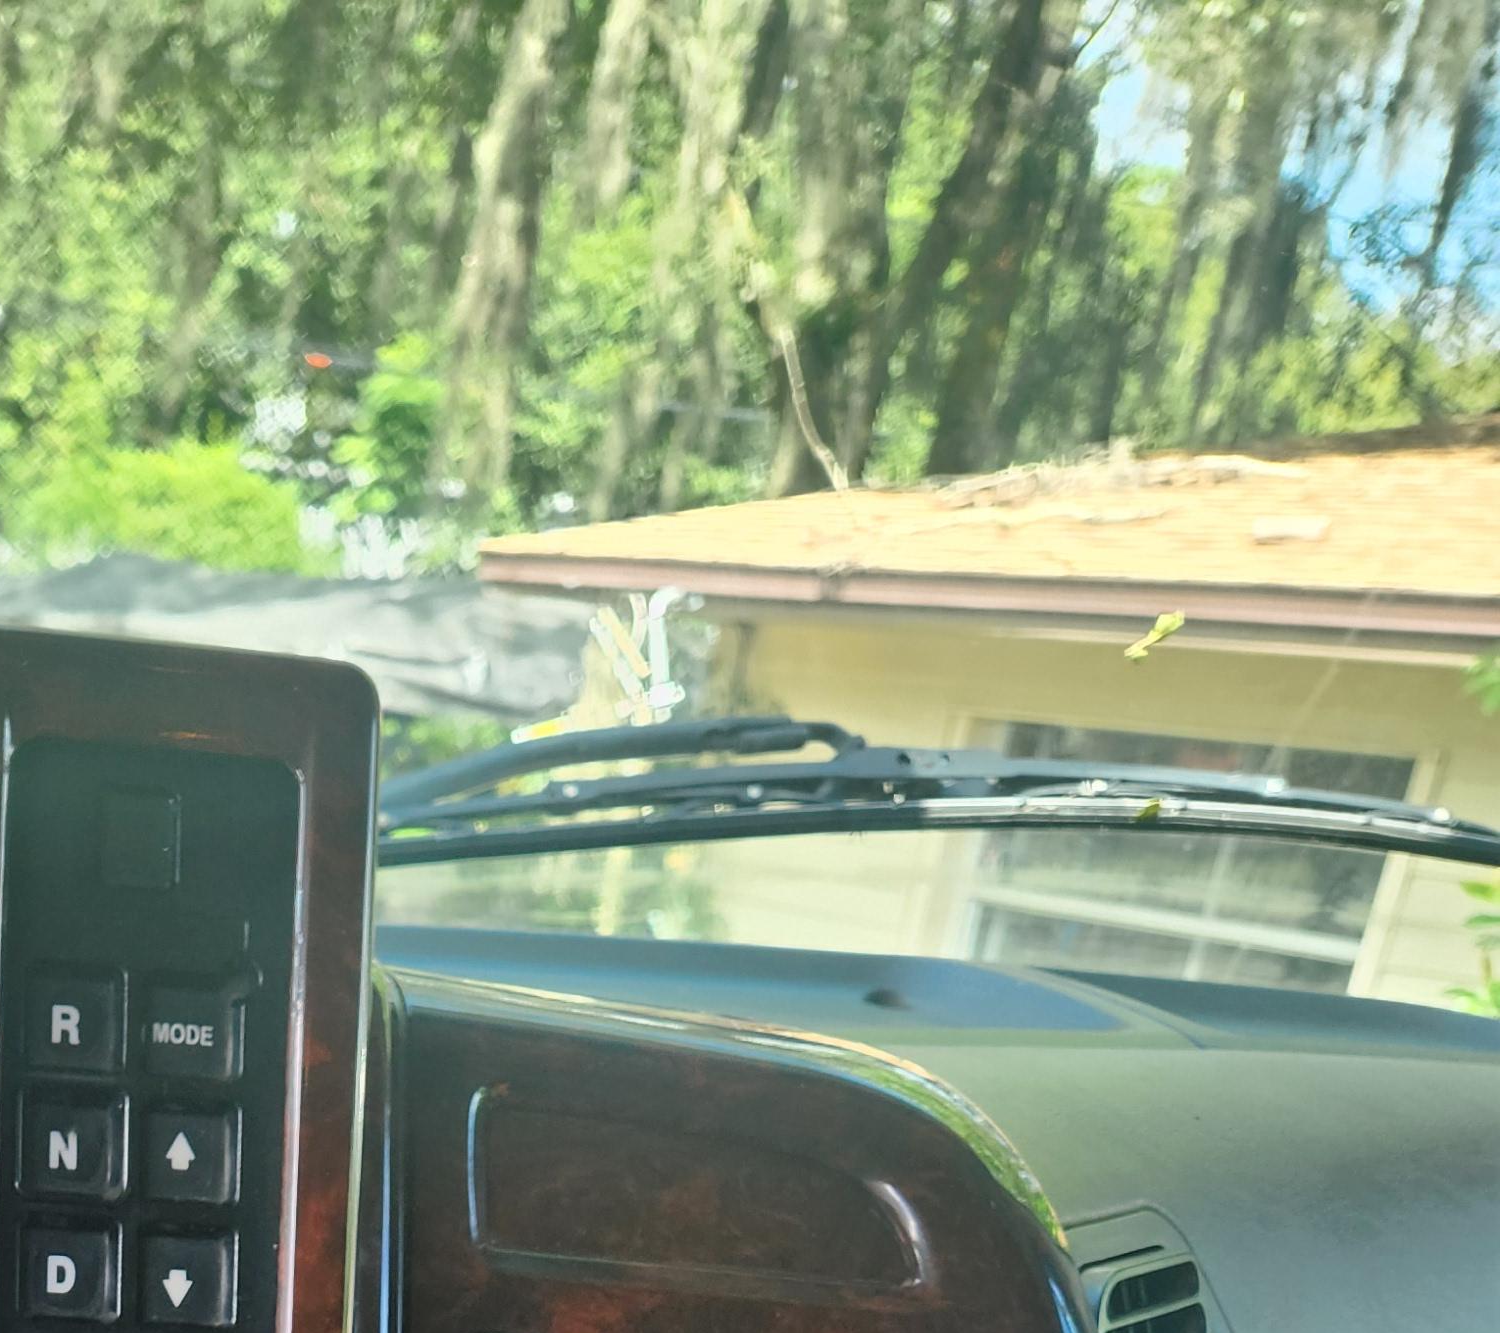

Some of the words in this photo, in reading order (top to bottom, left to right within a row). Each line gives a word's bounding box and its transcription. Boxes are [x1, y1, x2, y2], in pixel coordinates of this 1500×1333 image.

[51, 1004, 81, 1045] R
[152, 1021, 215, 1048] MODE
[48, 1130, 79, 1171] N
[46, 1255, 76, 1295] D
